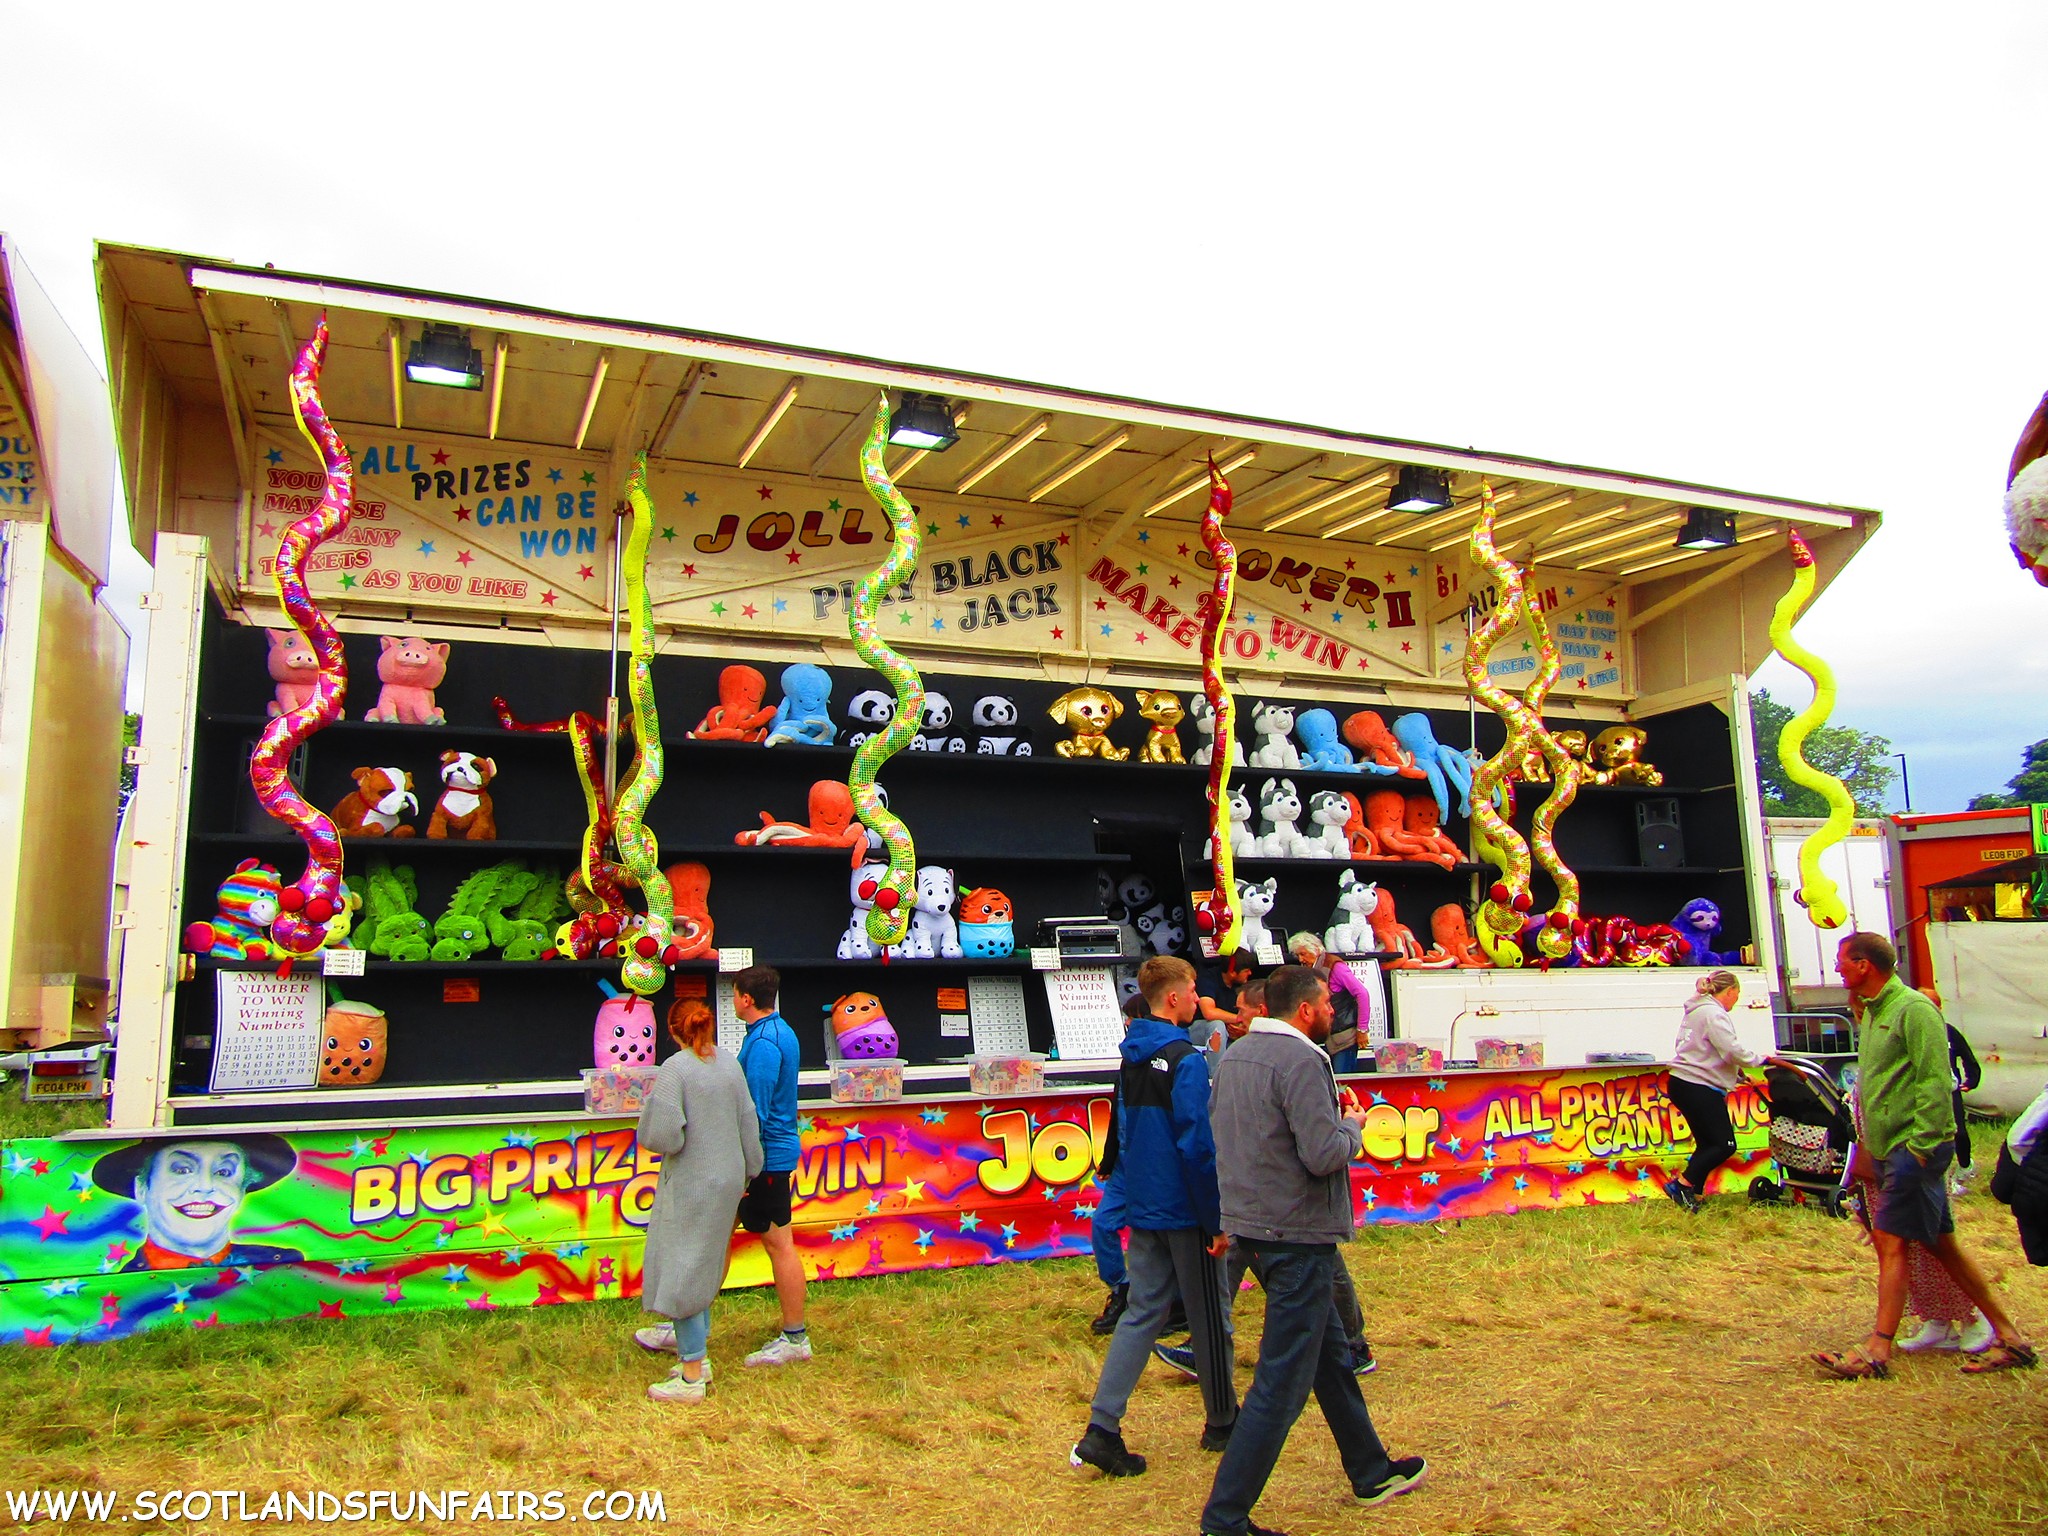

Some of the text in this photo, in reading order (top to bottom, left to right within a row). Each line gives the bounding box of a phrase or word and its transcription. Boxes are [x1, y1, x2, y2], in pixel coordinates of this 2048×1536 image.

[360, 445, 420, 475] ALL
[268, 468, 325, 491] YOU
[412, 460, 531, 500] PRIZES
[351, 500, 386, 521] SE
[476, 490, 597, 527] CAN BE
[328, 526, 401, 547] ANY
[520, 527, 597, 559] WON
[259, 549, 372, 576] TKETS
[930, 539, 1063, 595] BLACK
[362, 569, 528, 599] AS YOU LIKE
[1437, 573, 1458, 598] BI
[958, 583, 1062, 632] JACK
[1086, 554, 1202, 650] MAKE
[1383, 590, 1416, 628] II
[1586, 609, 1615, 624] YOU
[1269, 616, 1351, 671] WIN
[1557, 624, 1617, 642] MAY USE
[1562, 642, 1601, 658] MANY
[1587, 667, 1618, 688] LIKE
[234, 973, 270, 981] ANY
[237, 984, 310, 994] NUMBER
[241, 996, 305, 1005] TO WIN
[1060, 993, 1107, 1002] Winning
[1062, 1003, 1110, 1011] Numbers
[238, 1021, 305, 1031] Numbers
[240, 1008, 304, 1020] Winning
[1484, 1092, 1554, 1142] ALL
[1585, 1104, 1663, 1156] CAN
[351, 1153, 474, 1227] BIG
